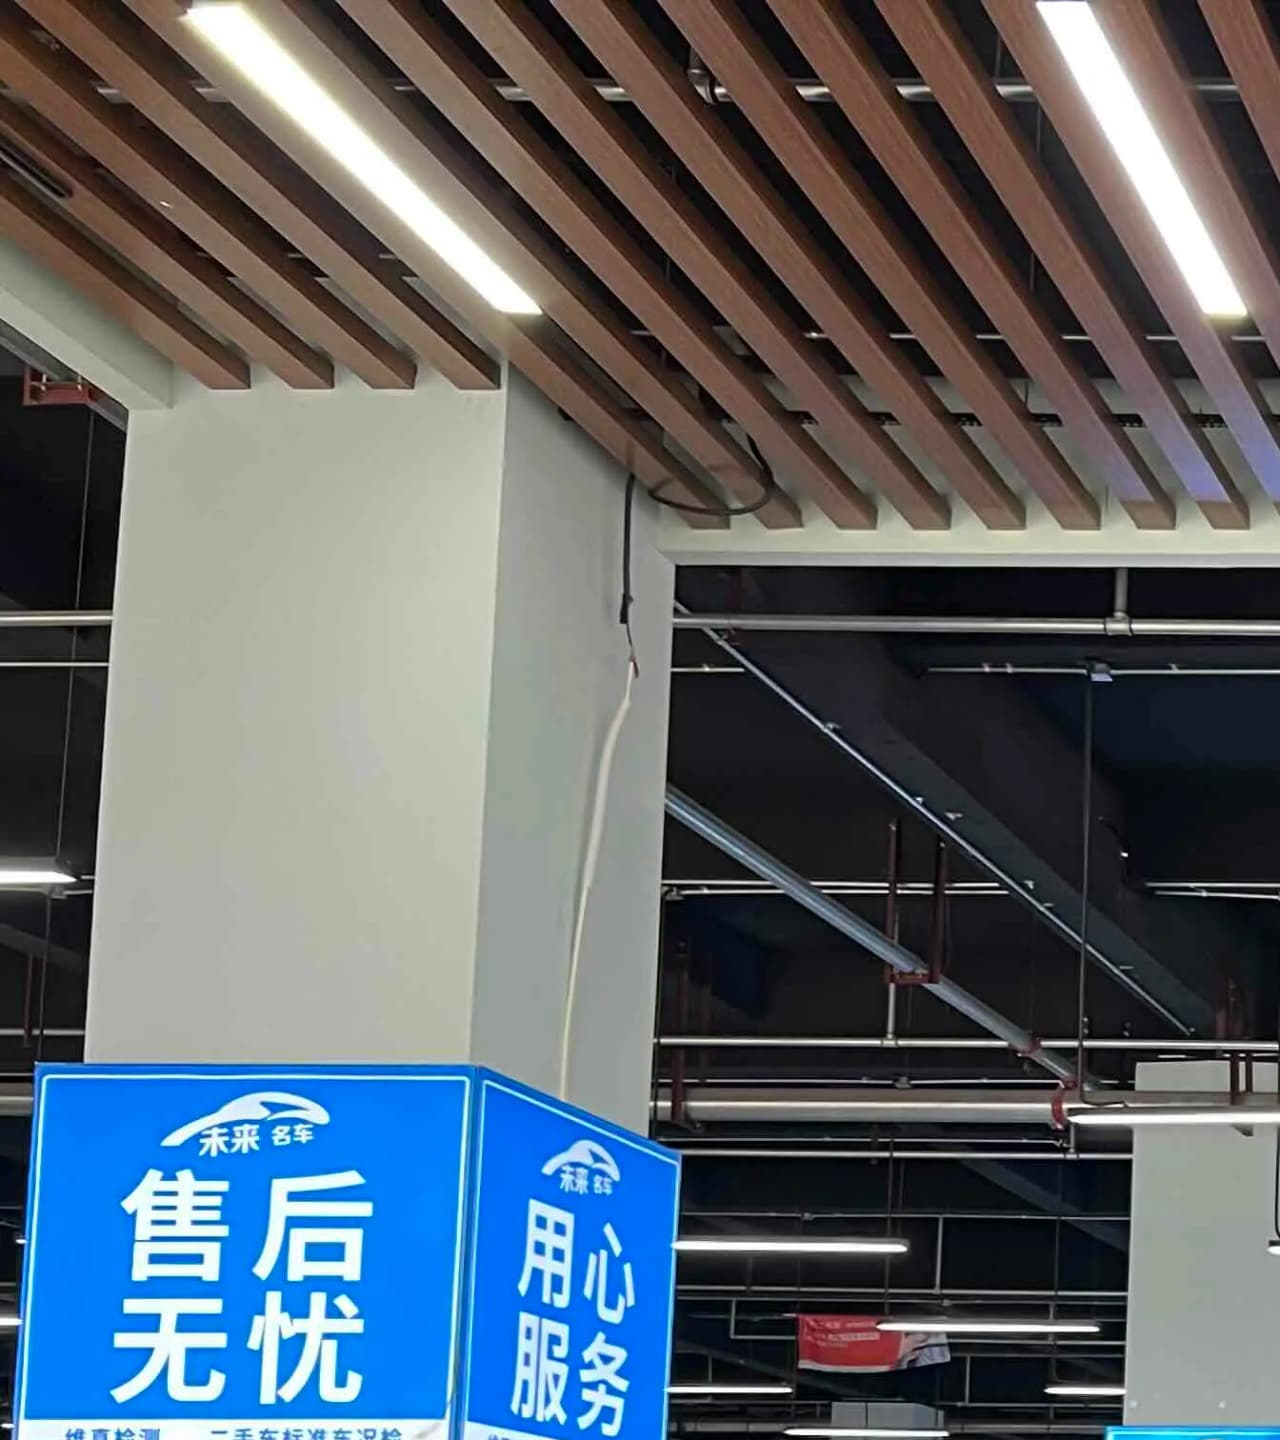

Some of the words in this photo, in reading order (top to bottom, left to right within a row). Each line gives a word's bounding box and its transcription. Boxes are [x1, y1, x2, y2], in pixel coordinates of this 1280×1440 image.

[120, 1169, 373, 1282] 售后
[517, 1198, 636, 1325] 用心
[109, 1291, 364, 1404] 无忧
[510, 1312, 632, 1437] 服务
